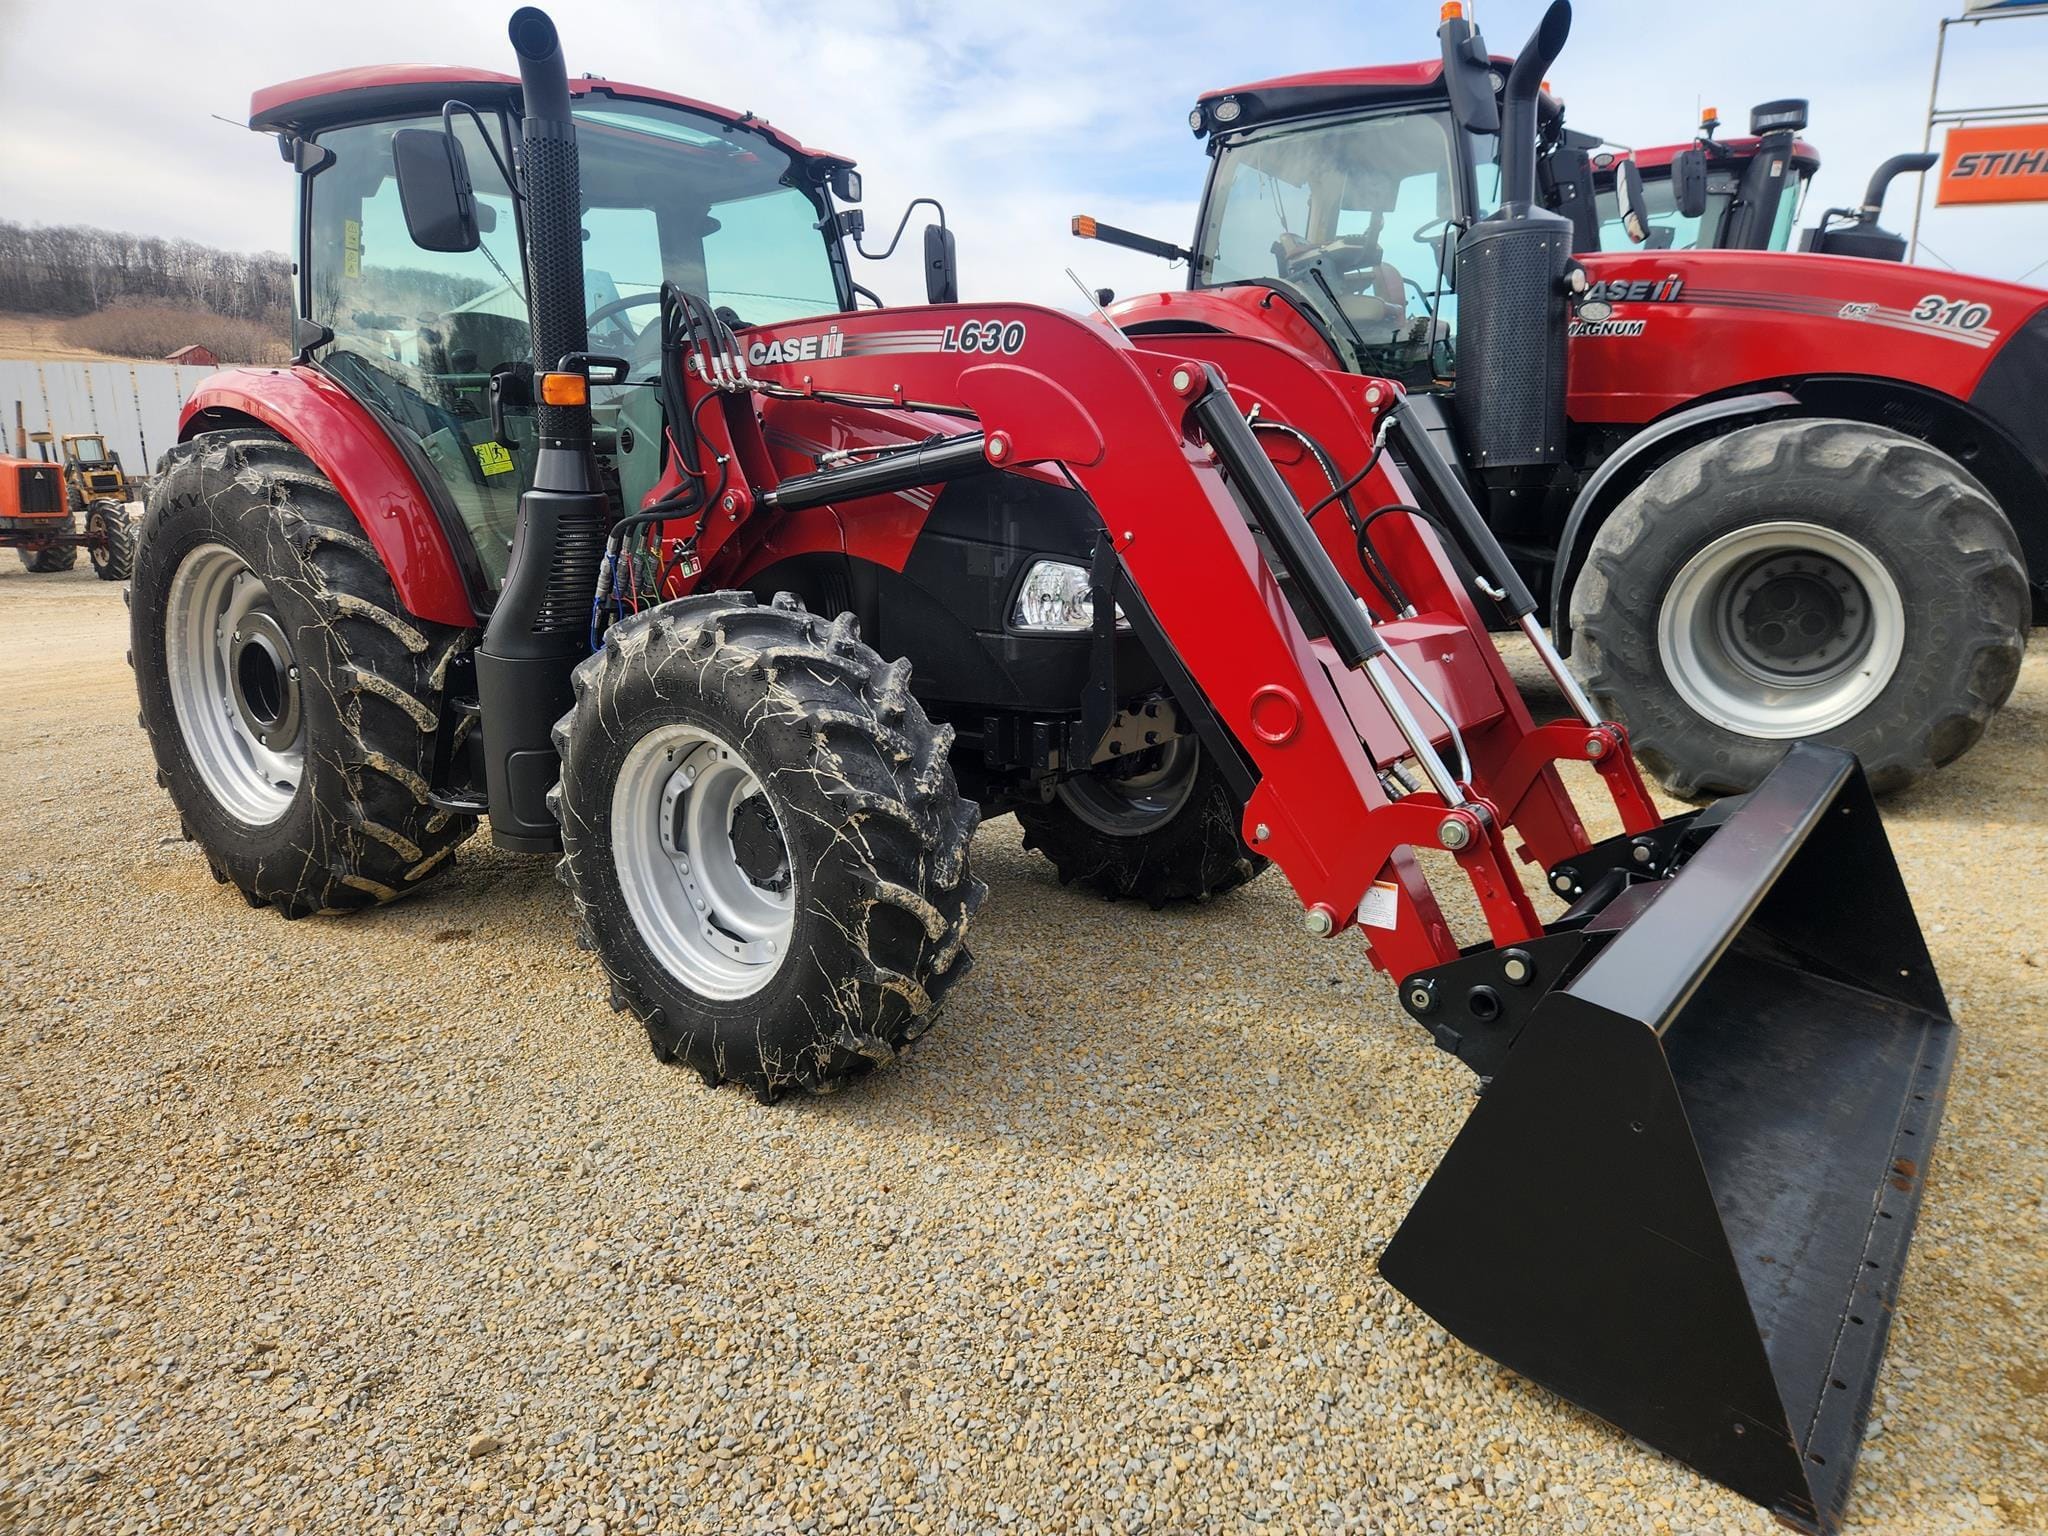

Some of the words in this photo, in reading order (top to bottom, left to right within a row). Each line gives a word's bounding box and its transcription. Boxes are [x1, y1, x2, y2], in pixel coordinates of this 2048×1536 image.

[1582, 279, 1651, 301] ASE
[1912, 295, 1991, 332] 310
[748, 336, 818, 366] CASE
[941, 319, 1026, 355] L630
